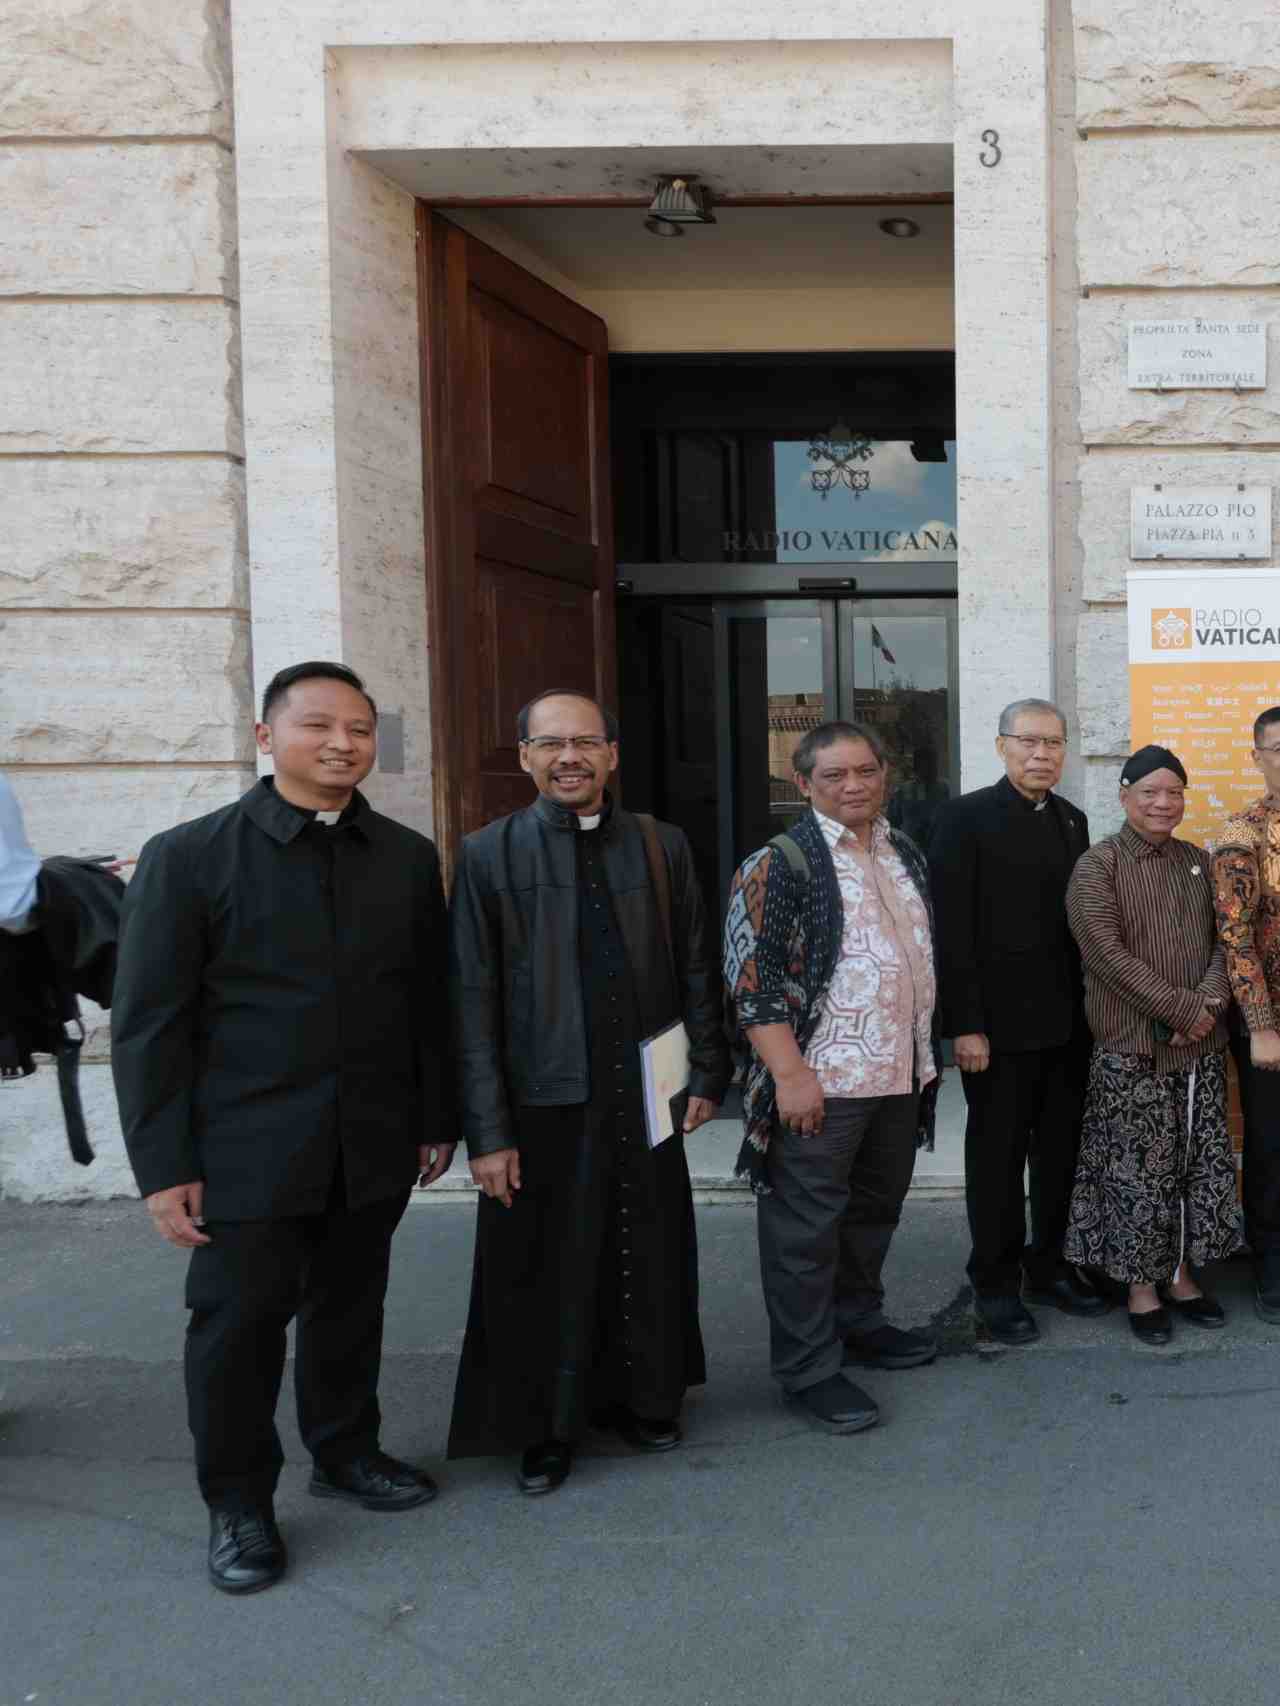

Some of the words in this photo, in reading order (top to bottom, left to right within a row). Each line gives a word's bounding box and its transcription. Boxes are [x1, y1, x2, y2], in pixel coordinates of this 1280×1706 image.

[979, 129, 1002, 168] 3
[1196, 324, 1230, 334] SANTA
[1236, 324, 1261, 334] SEDE
[1181, 349, 1213, 359] ZONA
[1137, 373, 1173, 383] EXTRA
[1178, 372, 1256, 383] TERRITORIALE
[1144, 504, 1219, 518] PALAZZO
[1226, 503, 1257, 518] PIO
[722, 531, 812, 551] RADIO
[819, 530, 958, 551] VATICANA
[1146, 528, 1197, 541] PIAZZA
[1202, 528, 1225, 541] PIA
[1195, 608, 1262, 626] RADIO
